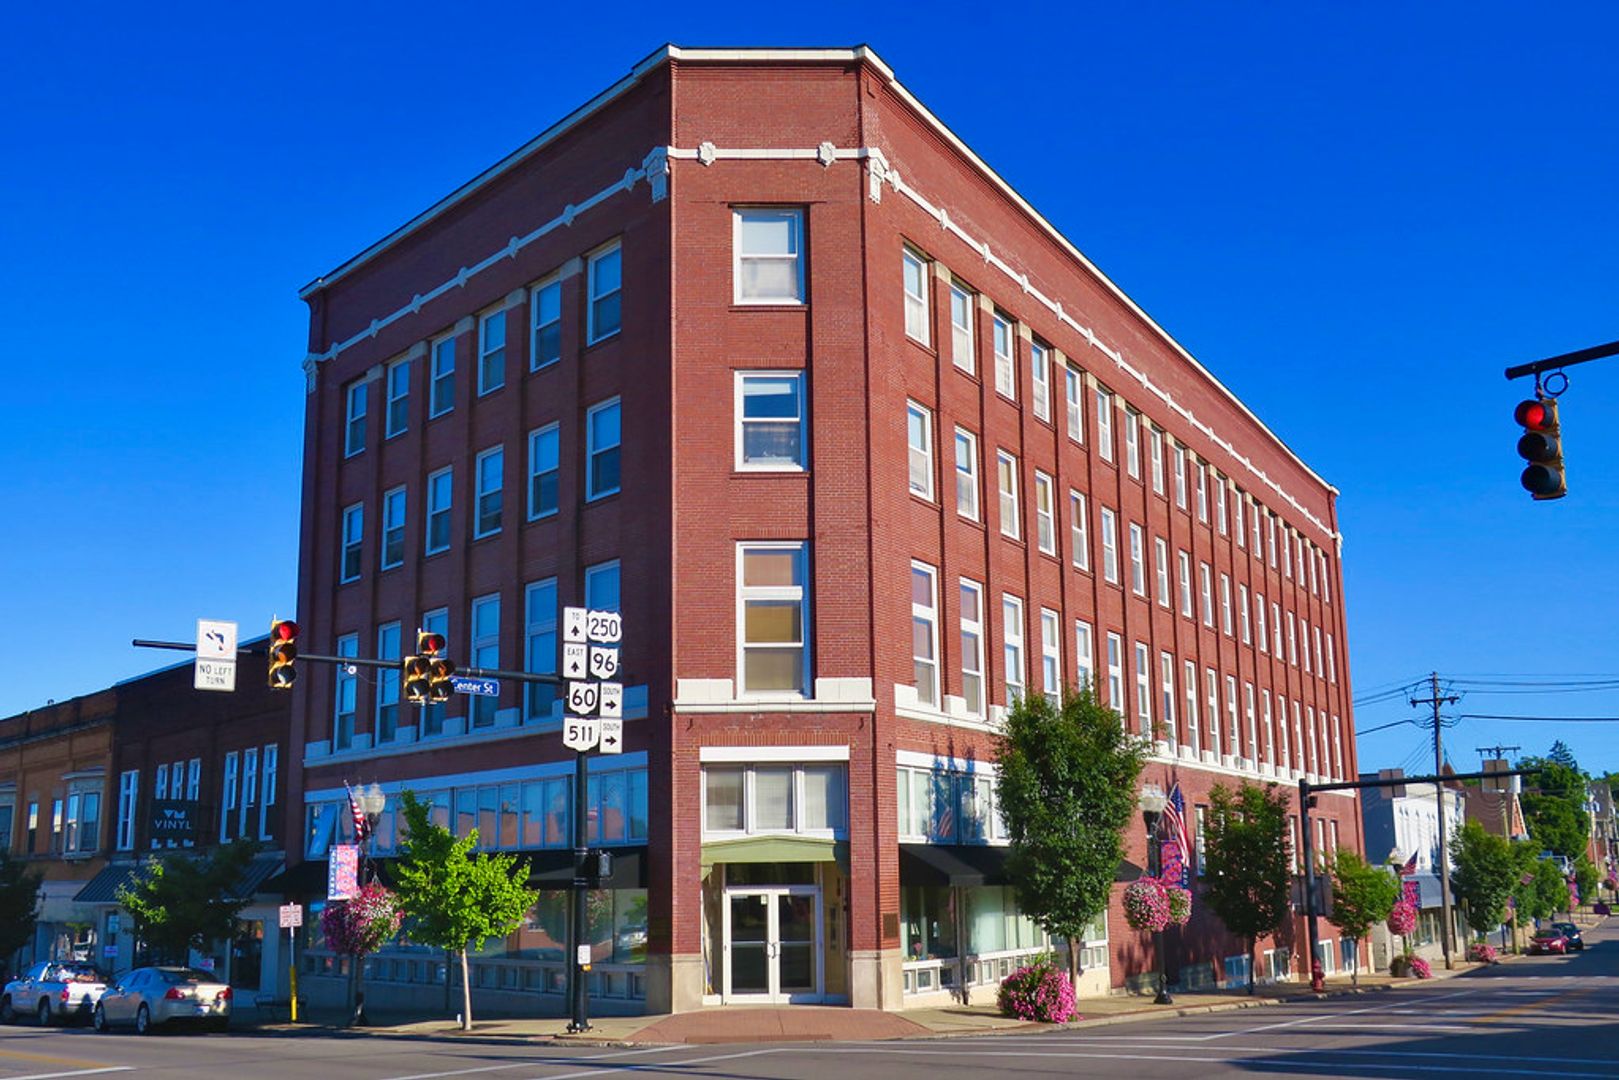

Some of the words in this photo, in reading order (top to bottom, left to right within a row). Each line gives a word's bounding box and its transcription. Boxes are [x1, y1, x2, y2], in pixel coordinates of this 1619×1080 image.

[572, 612, 580, 621] TO
[591, 618, 618, 637] 250
[567, 648, 583, 656] EAST
[593, 653, 615, 672] 96
[200, 664, 212, 675] NO
[214, 667, 232, 676] LEFT
[206, 676, 225, 685] TURN
[483, 682, 494, 695] St
[572, 689, 596, 707] 60
[603, 687, 620, 695] SOUTH
[569, 725, 593, 742] 511
[603, 723, 620, 731] SOUTH
[154, 820, 192, 830] VINYL
